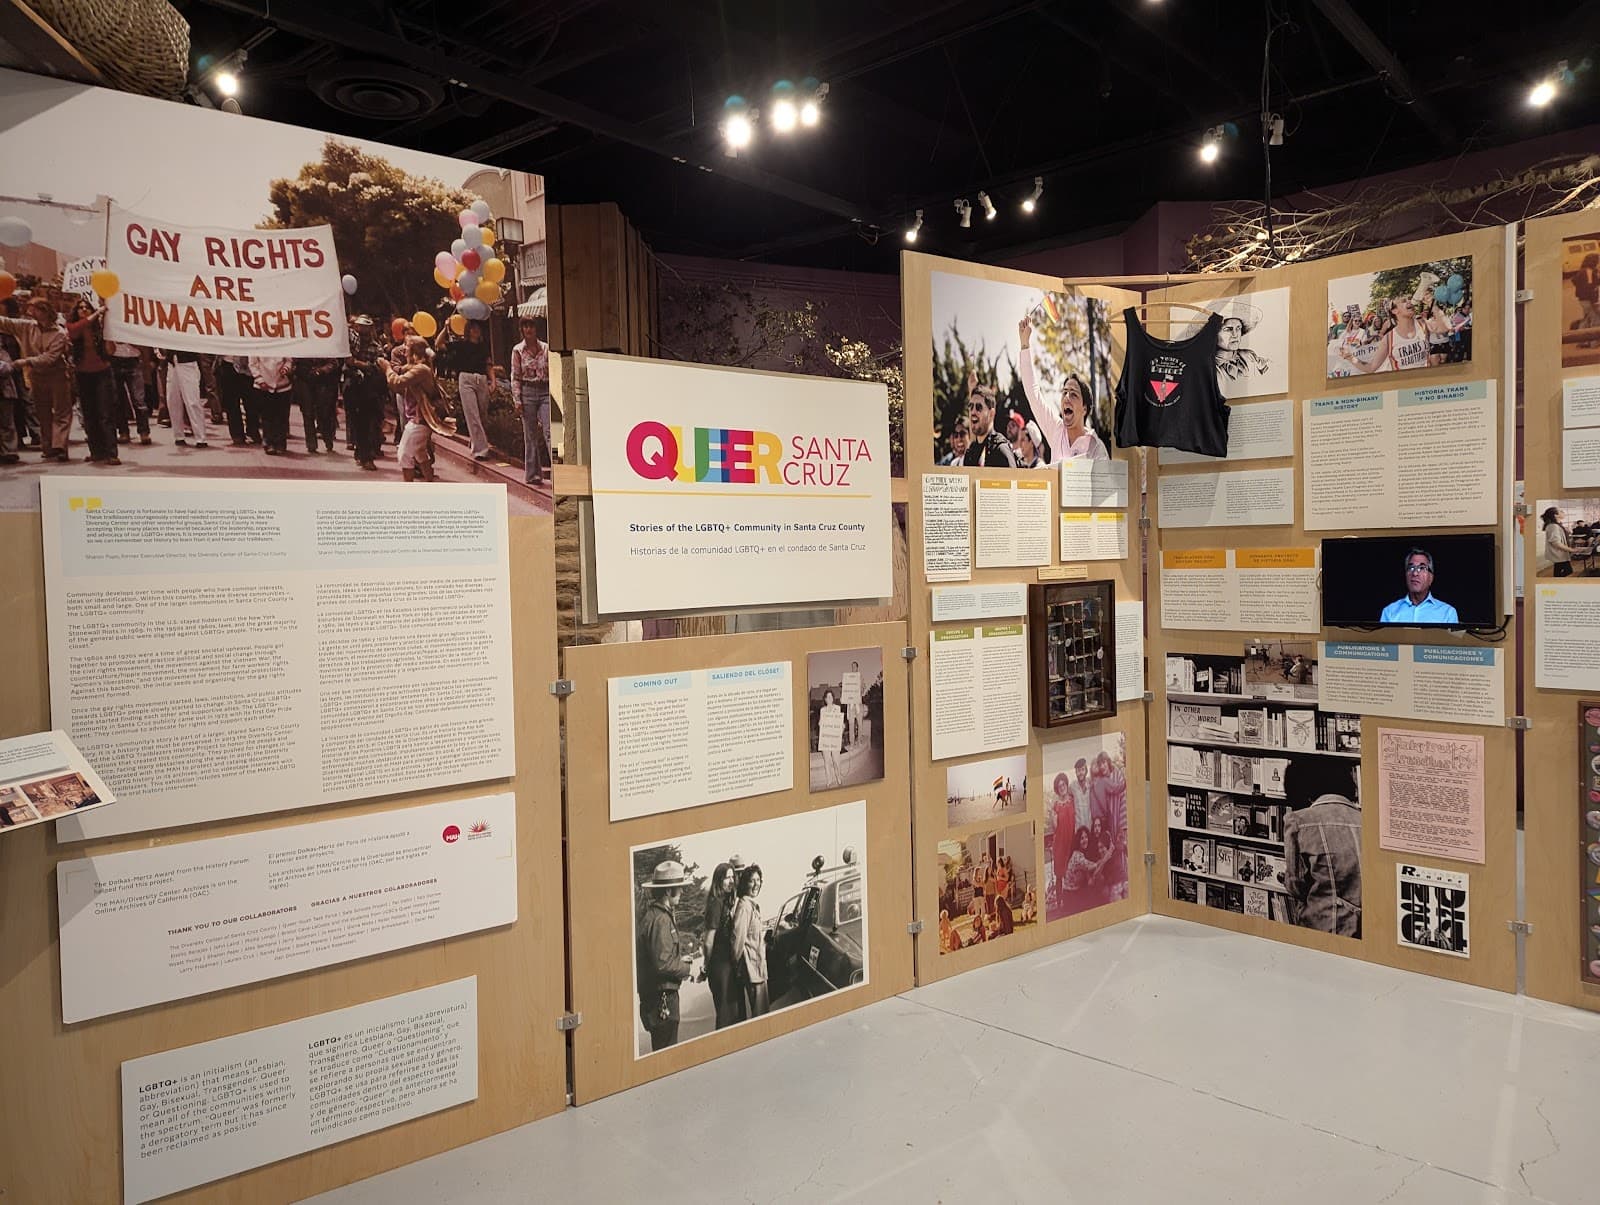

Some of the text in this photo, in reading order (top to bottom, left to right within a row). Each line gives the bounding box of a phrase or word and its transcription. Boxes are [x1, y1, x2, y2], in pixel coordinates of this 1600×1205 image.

[126, 222, 324, 269] GAY RIGHTS
[190, 276, 254, 302] ARE
[123, 293, 334, 339] HUMAN RIGHTS
[1340, 395, 1378, 404] NON-BINARY
[1414, 388, 1444, 396] HISTORIA
[626, 421, 872, 485] QUEER SANTA
[783, 462, 851, 486] CRUZ
[629, 524, 663, 532] Stories
[695, 524, 730, 532] LGBTQ+
[733, 523, 781, 533] Community
[783, 523, 791, 531] in
[793, 523, 816, 531] Santa
[818, 523, 836, 531] Cruz
[838, 523, 865, 532] County
[630, 547, 667, 555] Historias
[681, 546, 688, 554] la
[690, 545, 732, 554] comunidad
[734, 545, 765, 553] LGBTQ+
[778, 544, 785, 552] el
[787, 544, 816, 552] condado
[817, 543, 827, 551] de
[828, 543, 848, 551] Santa
[850, 543, 865, 551] Cruz
[711, 671, 743, 679] SALIENDO
[1183, 706, 1201, 714] OTHER
[1197, 715, 1217, 724] WORDS
[310, 896, 340, 907] GRACIAS
[348, 888, 382, 900] NUESTROS
[383, 878, 437, 893] COLABORADORES
[167, 926, 192, 935] THANK
[194, 922, 209, 930] YOU
[239, 905, 296, 921] COLLABORATORS
[308, 1036, 341, 1049] LGBTQ+
[366, 1019, 405, 1034] inicialismo
[308, 1048, 323, 1057] que
[324, 1039, 357, 1052] significa
[138, 1079, 178, 1093] LGBTQ+
[203, 1063, 241, 1077] initialism
[244, 1059, 257, 1068] (an
[139, 1082, 199, 1102] abbreviation)
[201, 1077, 219, 1087] that
[221, 1070, 250, 1082] means
[260, 1070, 285, 1081] Queer
[211, 1088, 247, 1102] LGBTQ+
[259, 1078, 278, 1089] used
[139, 1085, 291, 1130] mean all of the communities within
[139, 1131, 155, 1139] the
[240, 1103, 258, 1112] was
[260, 1093, 295, 1107] formerly
[147, 1128, 198, 1146] derogatory
[200, 1122, 222, 1132] term
[224, 1115, 238, 1125] but
[240, 1113, 246, 1121] it
[249, 1110, 264, 1118] has
[265, 1104, 286, 1114] since
[140, 1147, 163, 1157] been
[165, 1132, 209, 1150] reclaimed
[211, 1130, 222, 1138] as
